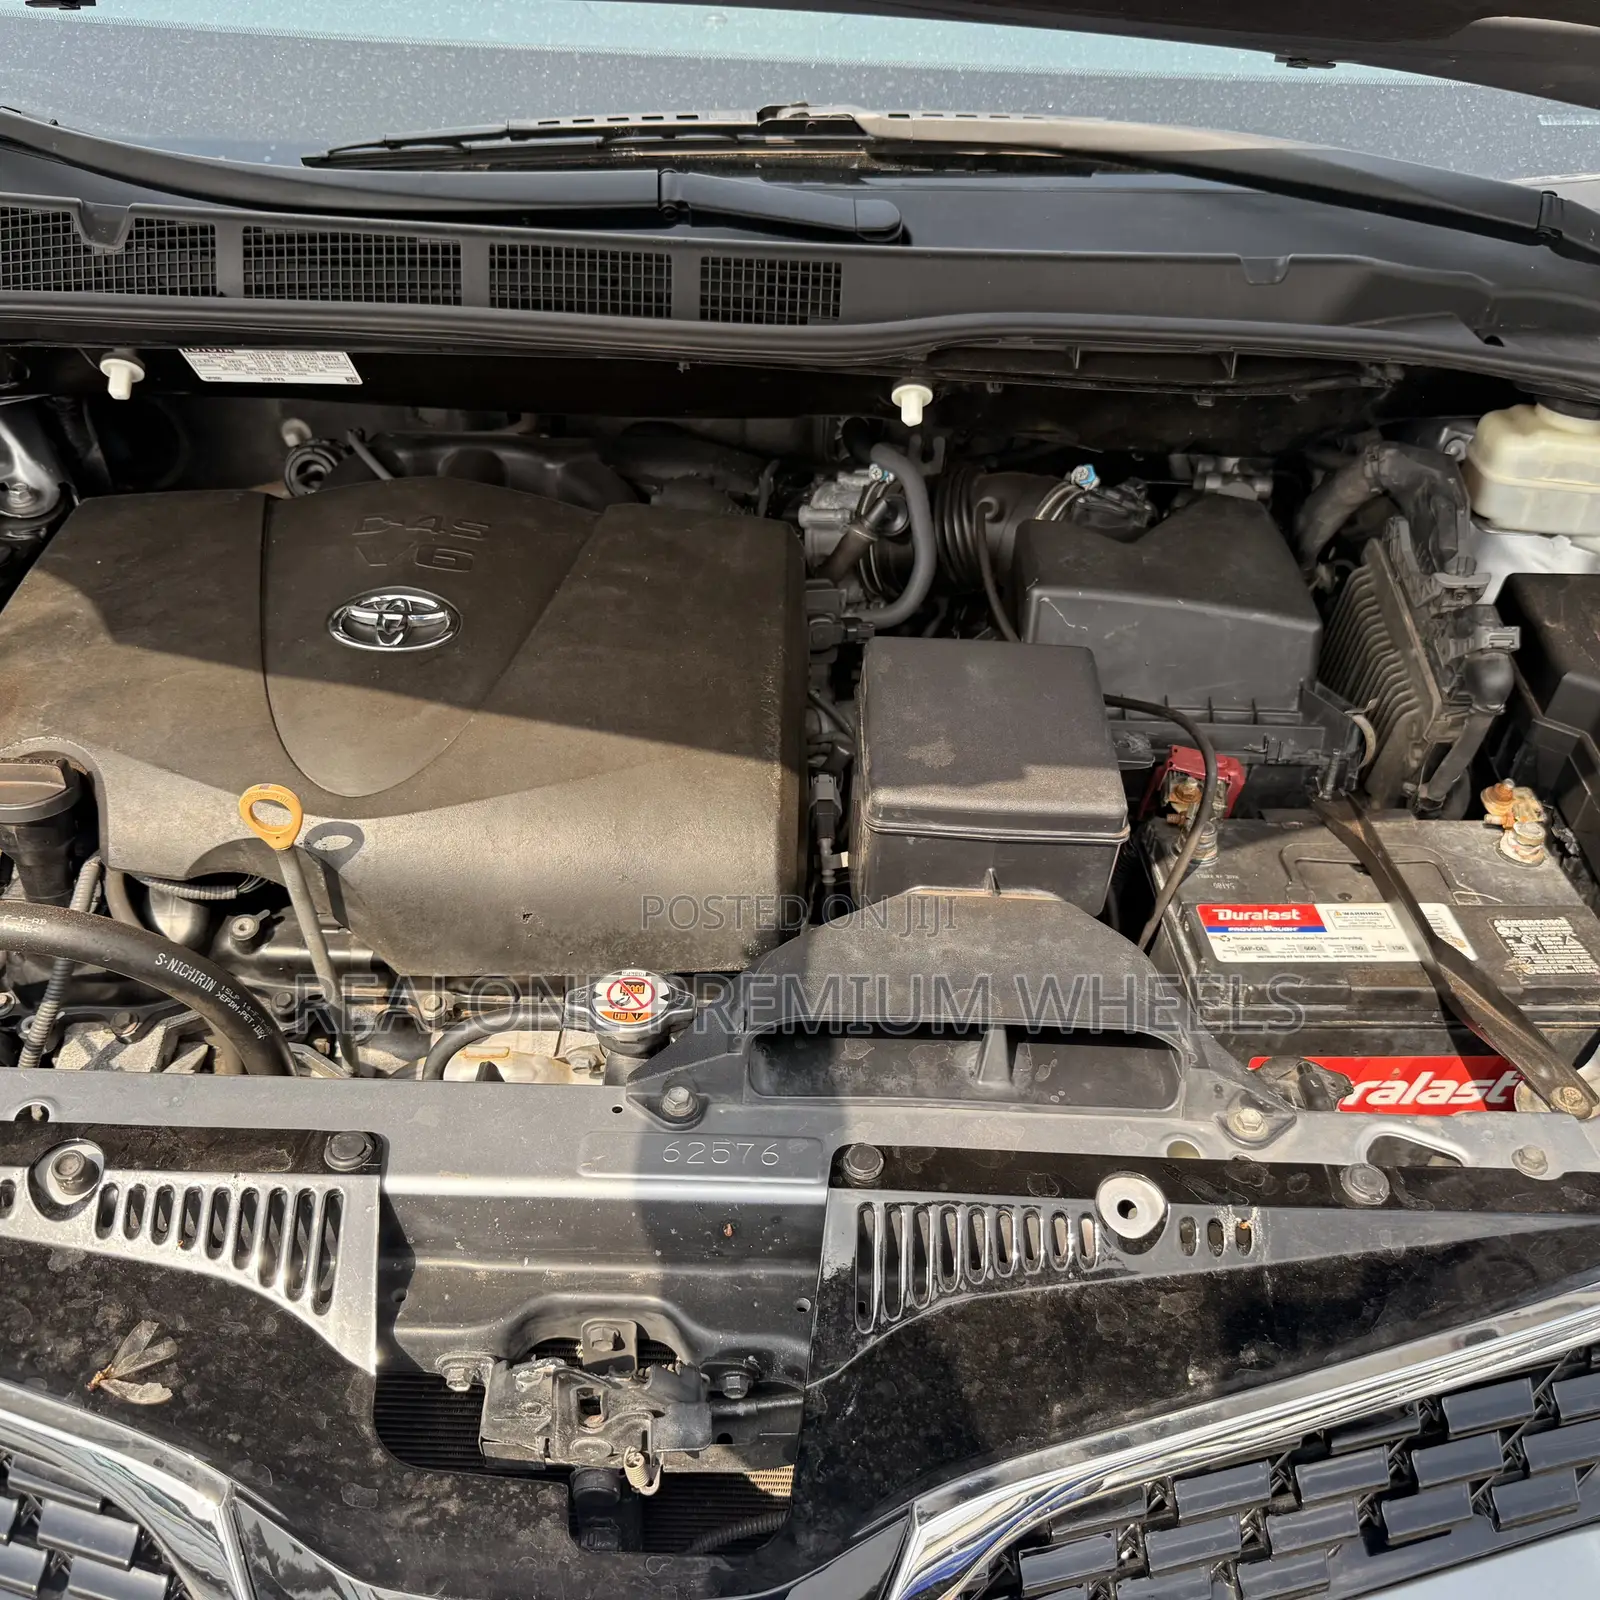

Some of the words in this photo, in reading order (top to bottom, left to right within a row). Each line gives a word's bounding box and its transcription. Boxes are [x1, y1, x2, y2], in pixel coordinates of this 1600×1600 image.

[355, 541, 475, 573] V6
[1212, 908, 1302, 921] Duralast
[1341, 1070, 1525, 1106] ralast
[662, 1140, 780, 1166] 62576
